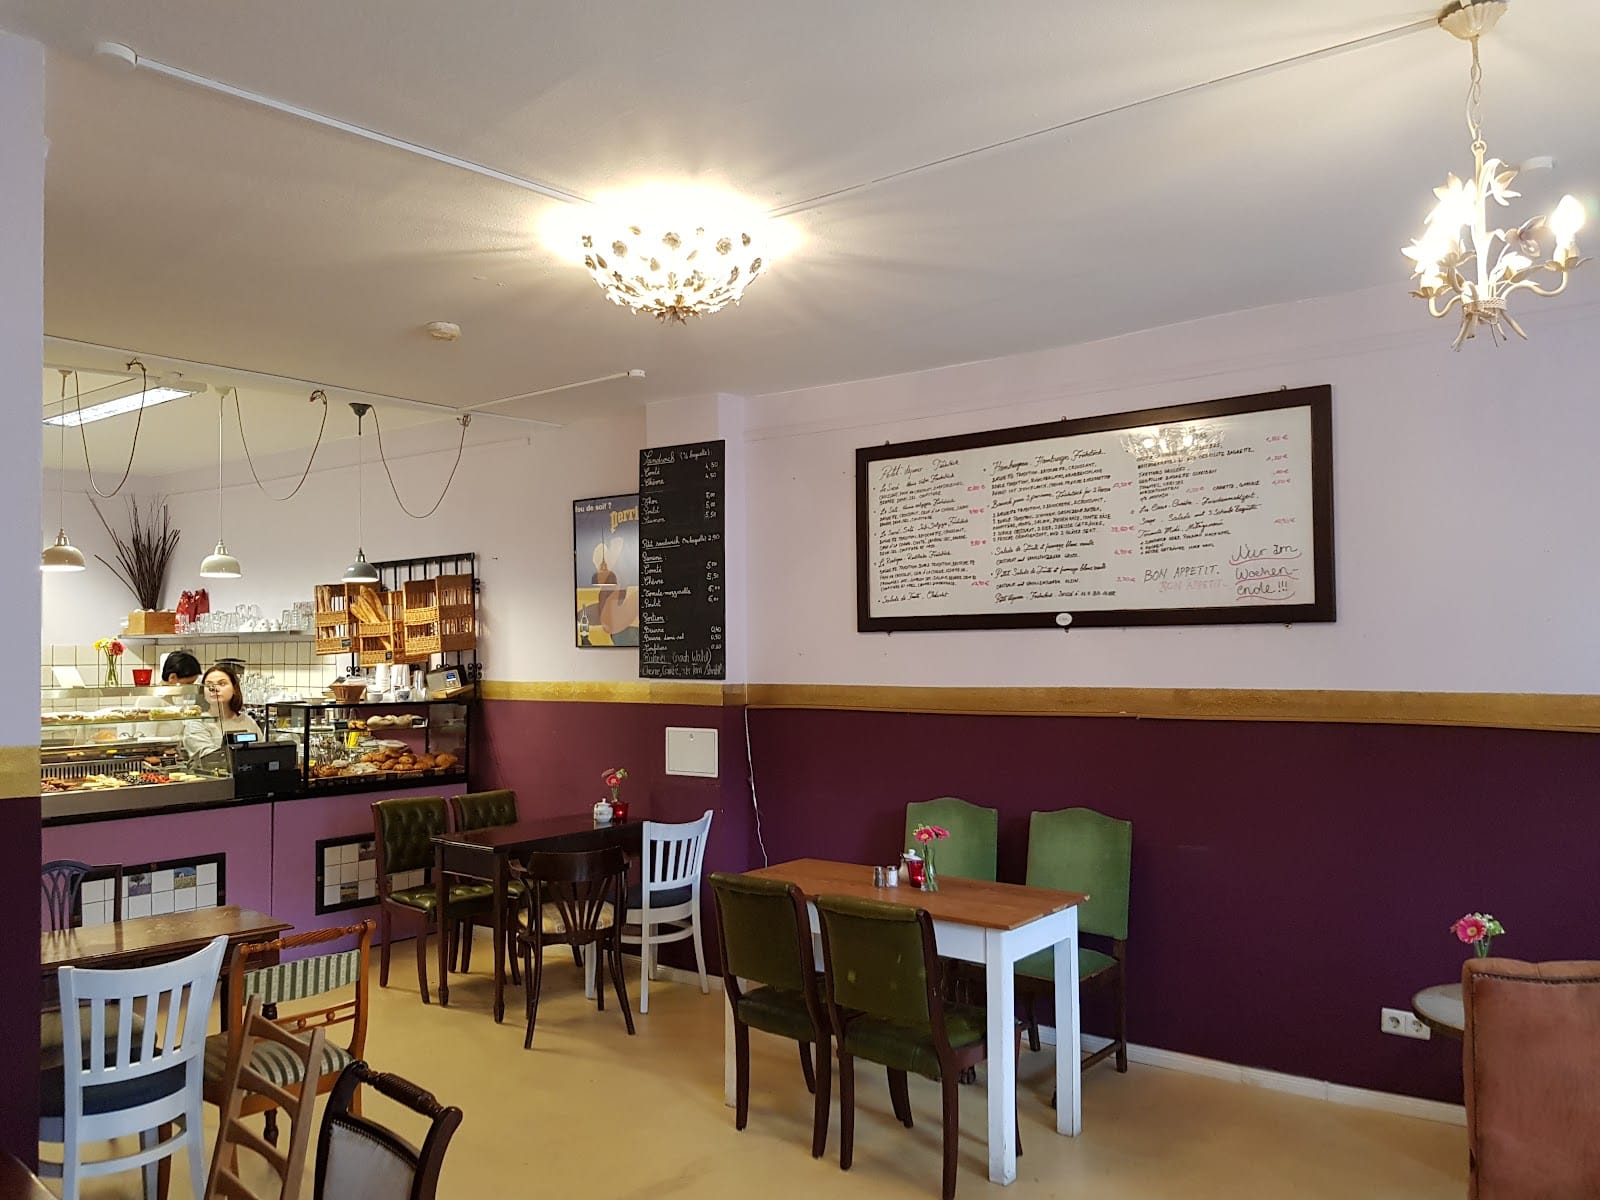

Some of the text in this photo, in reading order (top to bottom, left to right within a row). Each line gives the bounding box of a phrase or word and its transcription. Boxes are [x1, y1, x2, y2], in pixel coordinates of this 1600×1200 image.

[586, 504, 594, 512] de
[1232, 544, 1268, 562] Nur
[1144, 564, 1220, 583] BON APPETIT.
